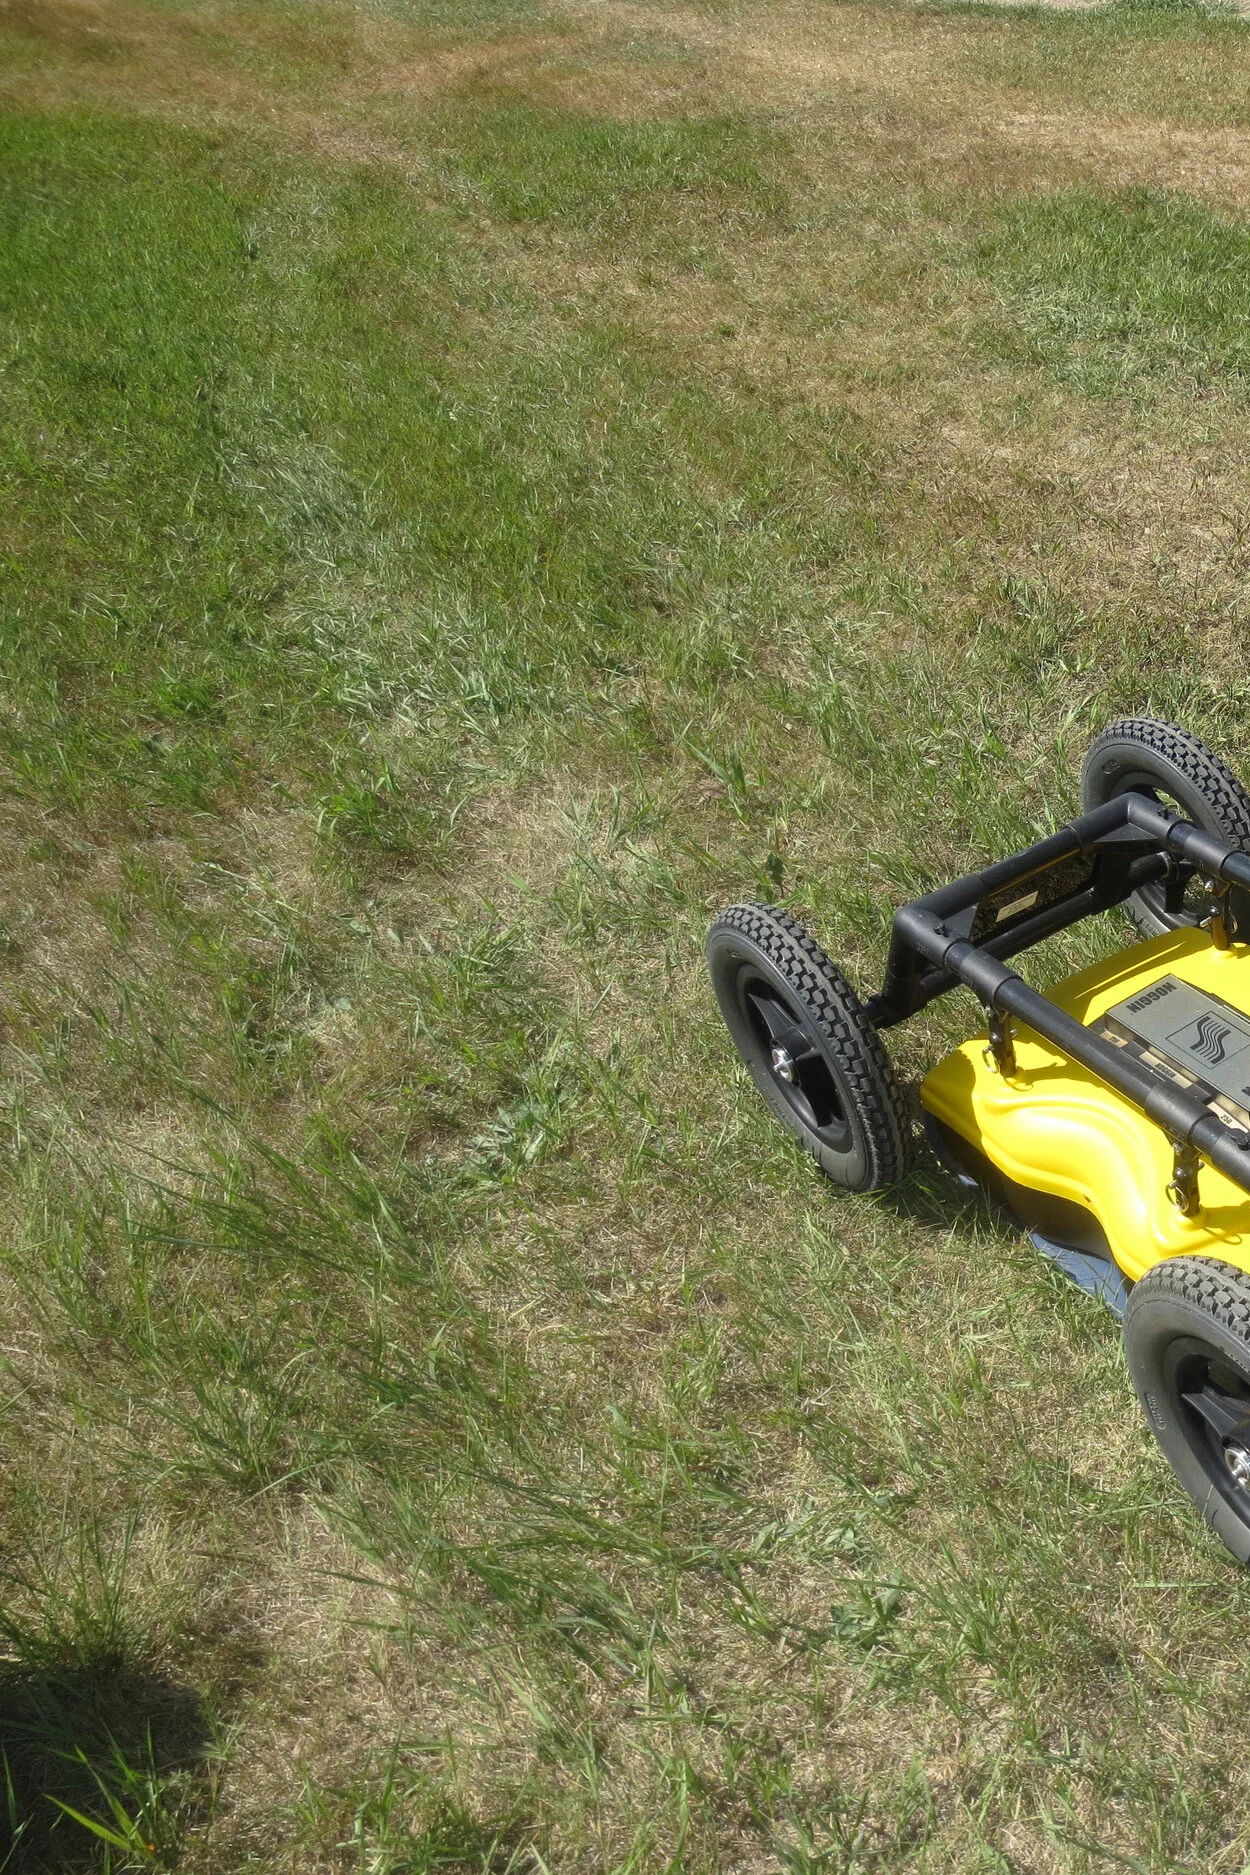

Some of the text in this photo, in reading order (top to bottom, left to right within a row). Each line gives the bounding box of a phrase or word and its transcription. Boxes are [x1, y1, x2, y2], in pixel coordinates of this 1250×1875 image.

[1126, 982, 1177, 1013] NOGGIN
[1155, 1062, 1178, 1079] NOGGIN
[1220, 1114, 1233, 1124] 250
